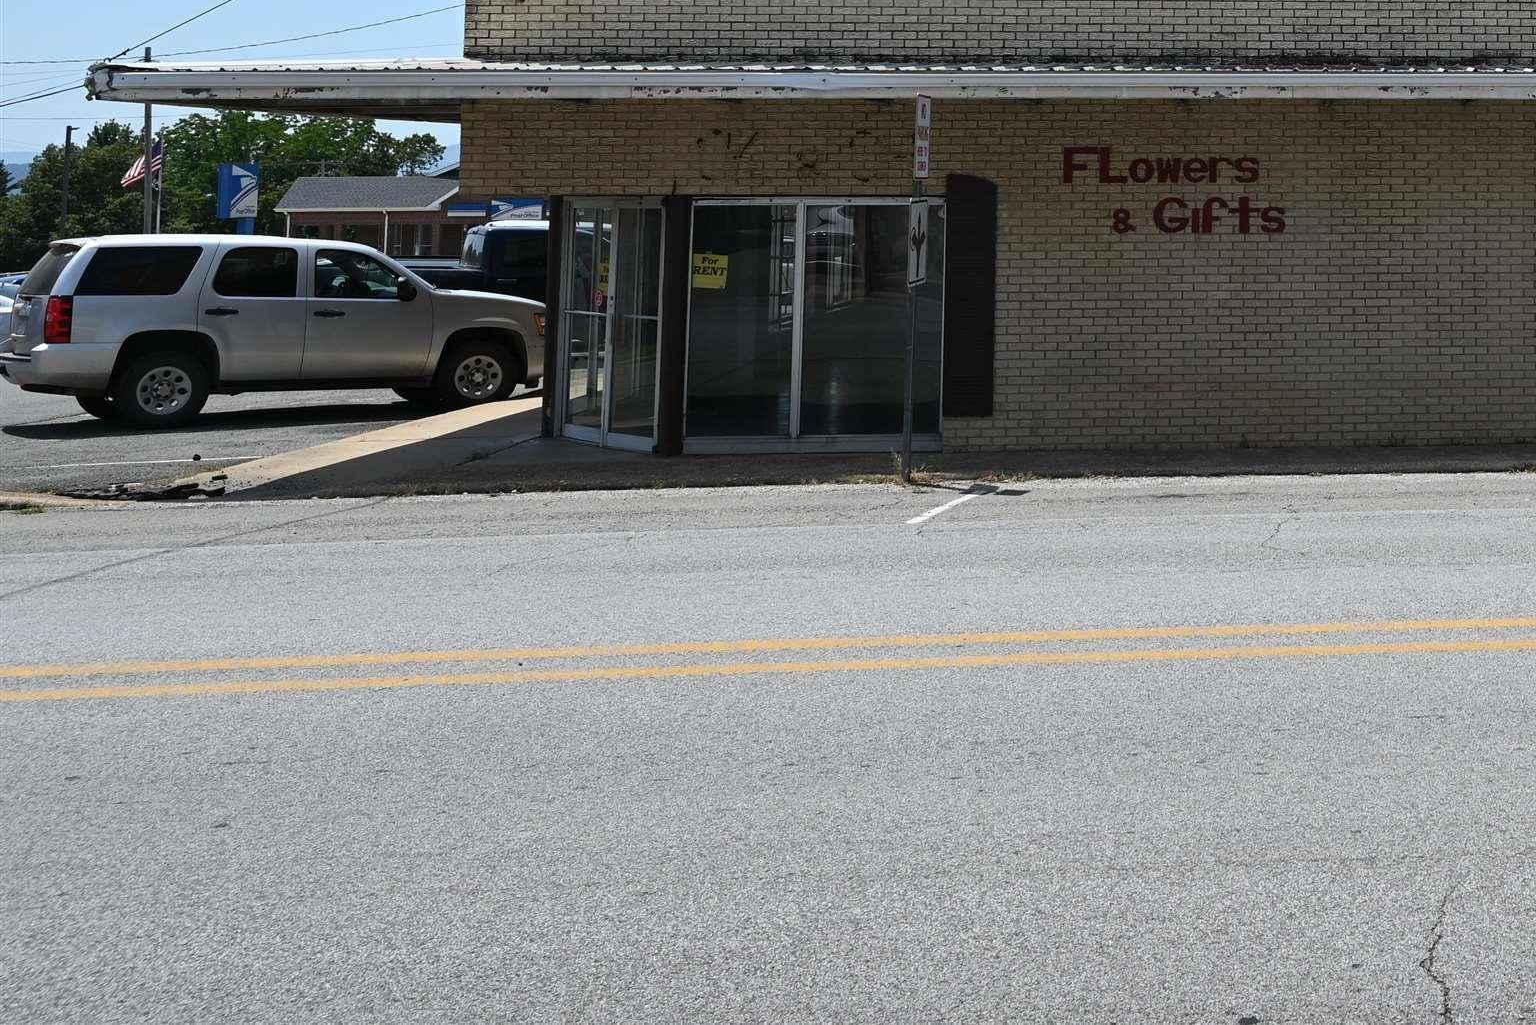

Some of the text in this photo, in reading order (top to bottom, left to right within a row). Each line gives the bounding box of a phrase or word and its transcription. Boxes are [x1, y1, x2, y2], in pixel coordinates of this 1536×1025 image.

[1112, 196, 1286, 234] & Gifts
[702, 256, 720, 265] For
[692, 266, 727, 276] RENT
